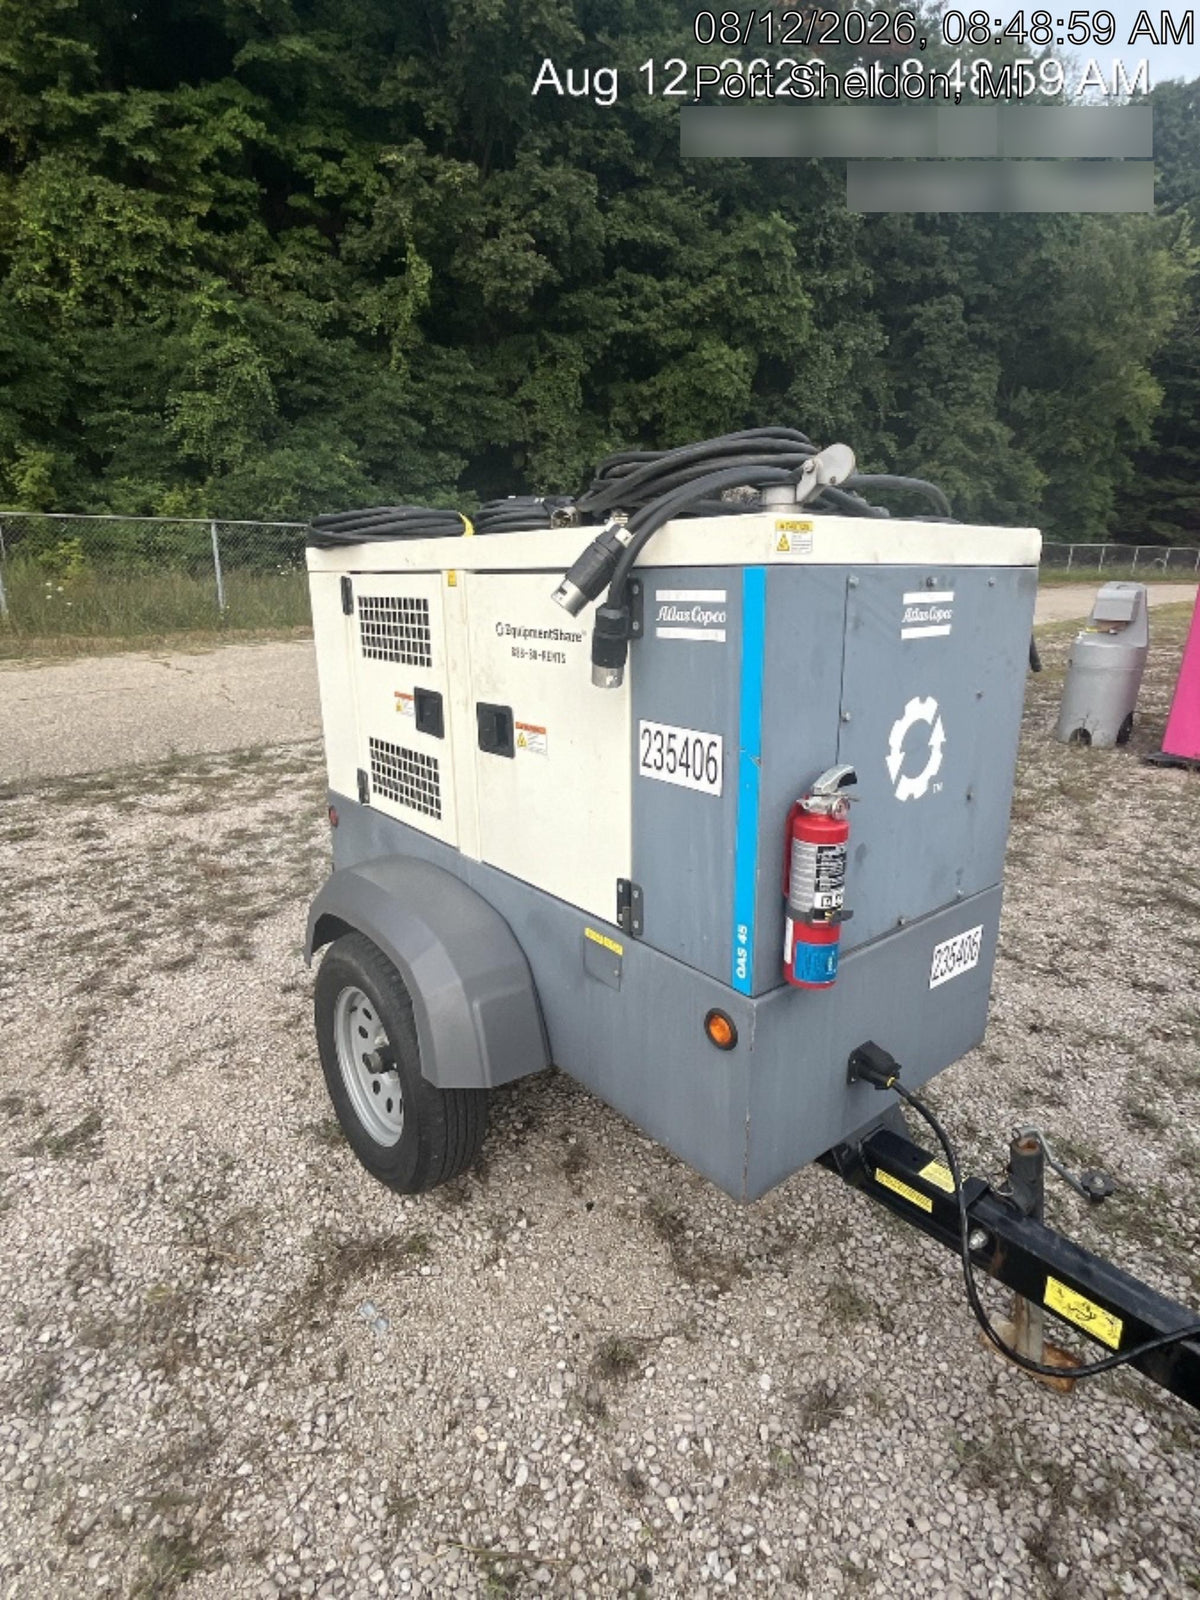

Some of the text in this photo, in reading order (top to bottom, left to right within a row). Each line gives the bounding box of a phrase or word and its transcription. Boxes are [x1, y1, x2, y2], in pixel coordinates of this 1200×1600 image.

[656, 605, 726, 626] Atlas Copco
[901, 605, 952, 623] Atlas Copco
[641, 727, 718, 785] 235406
[735, 923, 748, 979] QAS 45
[931, 930, 980, 981] 235406
